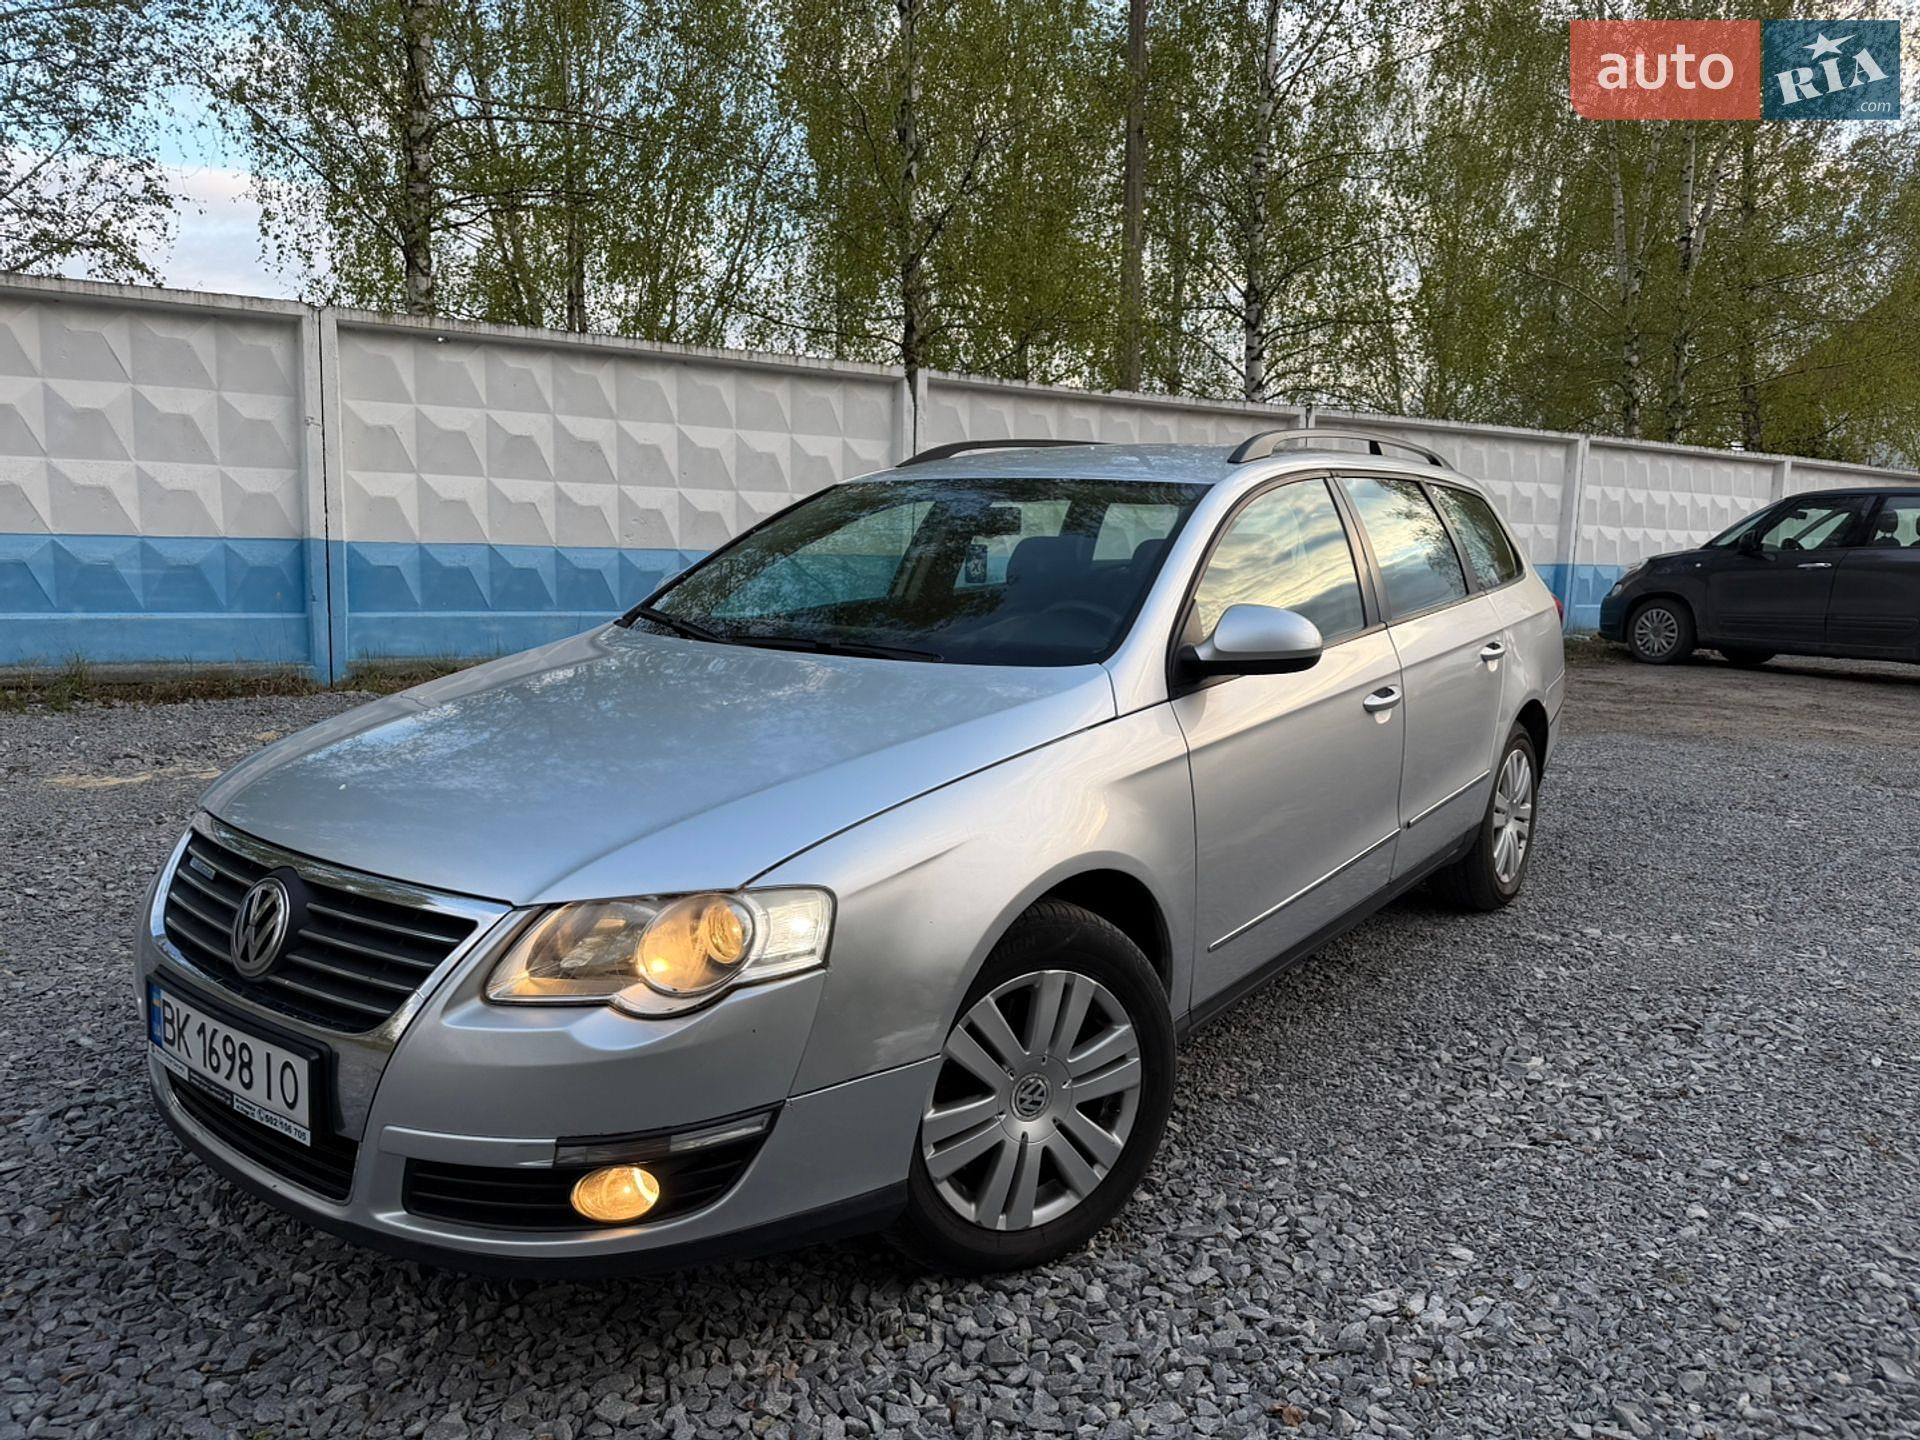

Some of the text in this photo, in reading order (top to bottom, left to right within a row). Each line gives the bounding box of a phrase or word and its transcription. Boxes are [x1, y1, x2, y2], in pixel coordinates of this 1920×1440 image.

[163, 999, 192, 1059] BK
[196, 1022, 253, 1090] 1698
[266, 1052, 298, 1110] IO
